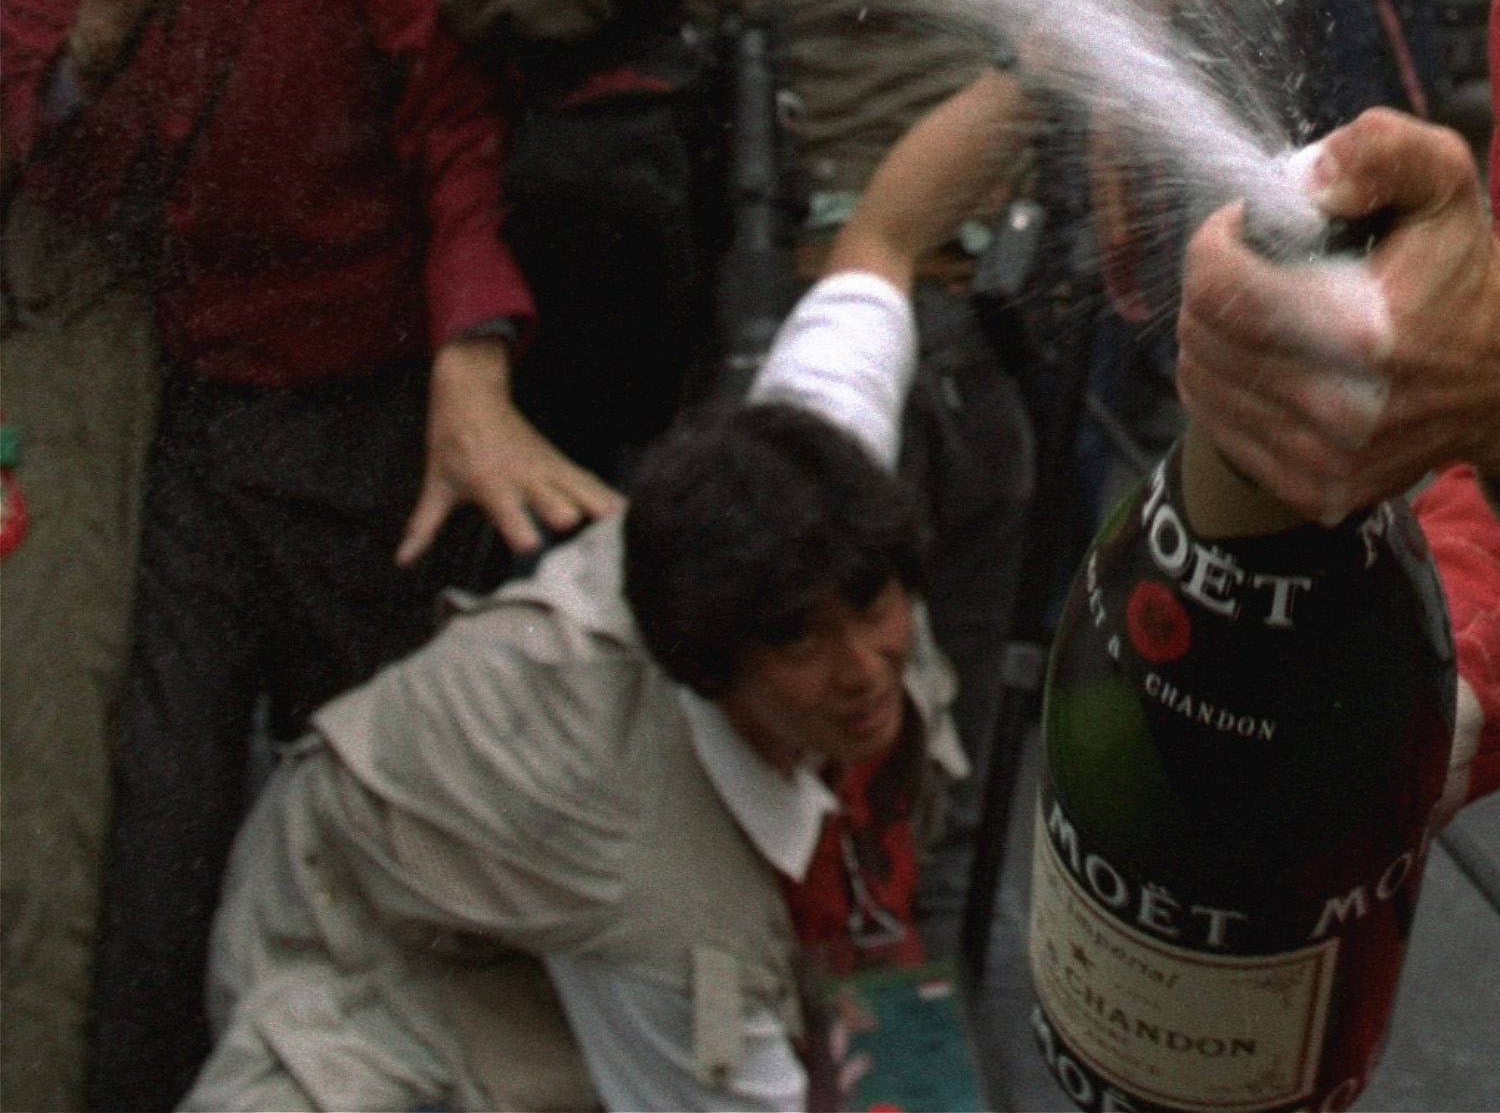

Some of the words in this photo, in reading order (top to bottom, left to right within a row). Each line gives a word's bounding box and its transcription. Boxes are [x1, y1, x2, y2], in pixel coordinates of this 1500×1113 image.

[1144, 671, 1278, 743] CHANDON
[1048, 799, 1250, 949] MOËT
[1064, 965, 1257, 1058] CHANDON
